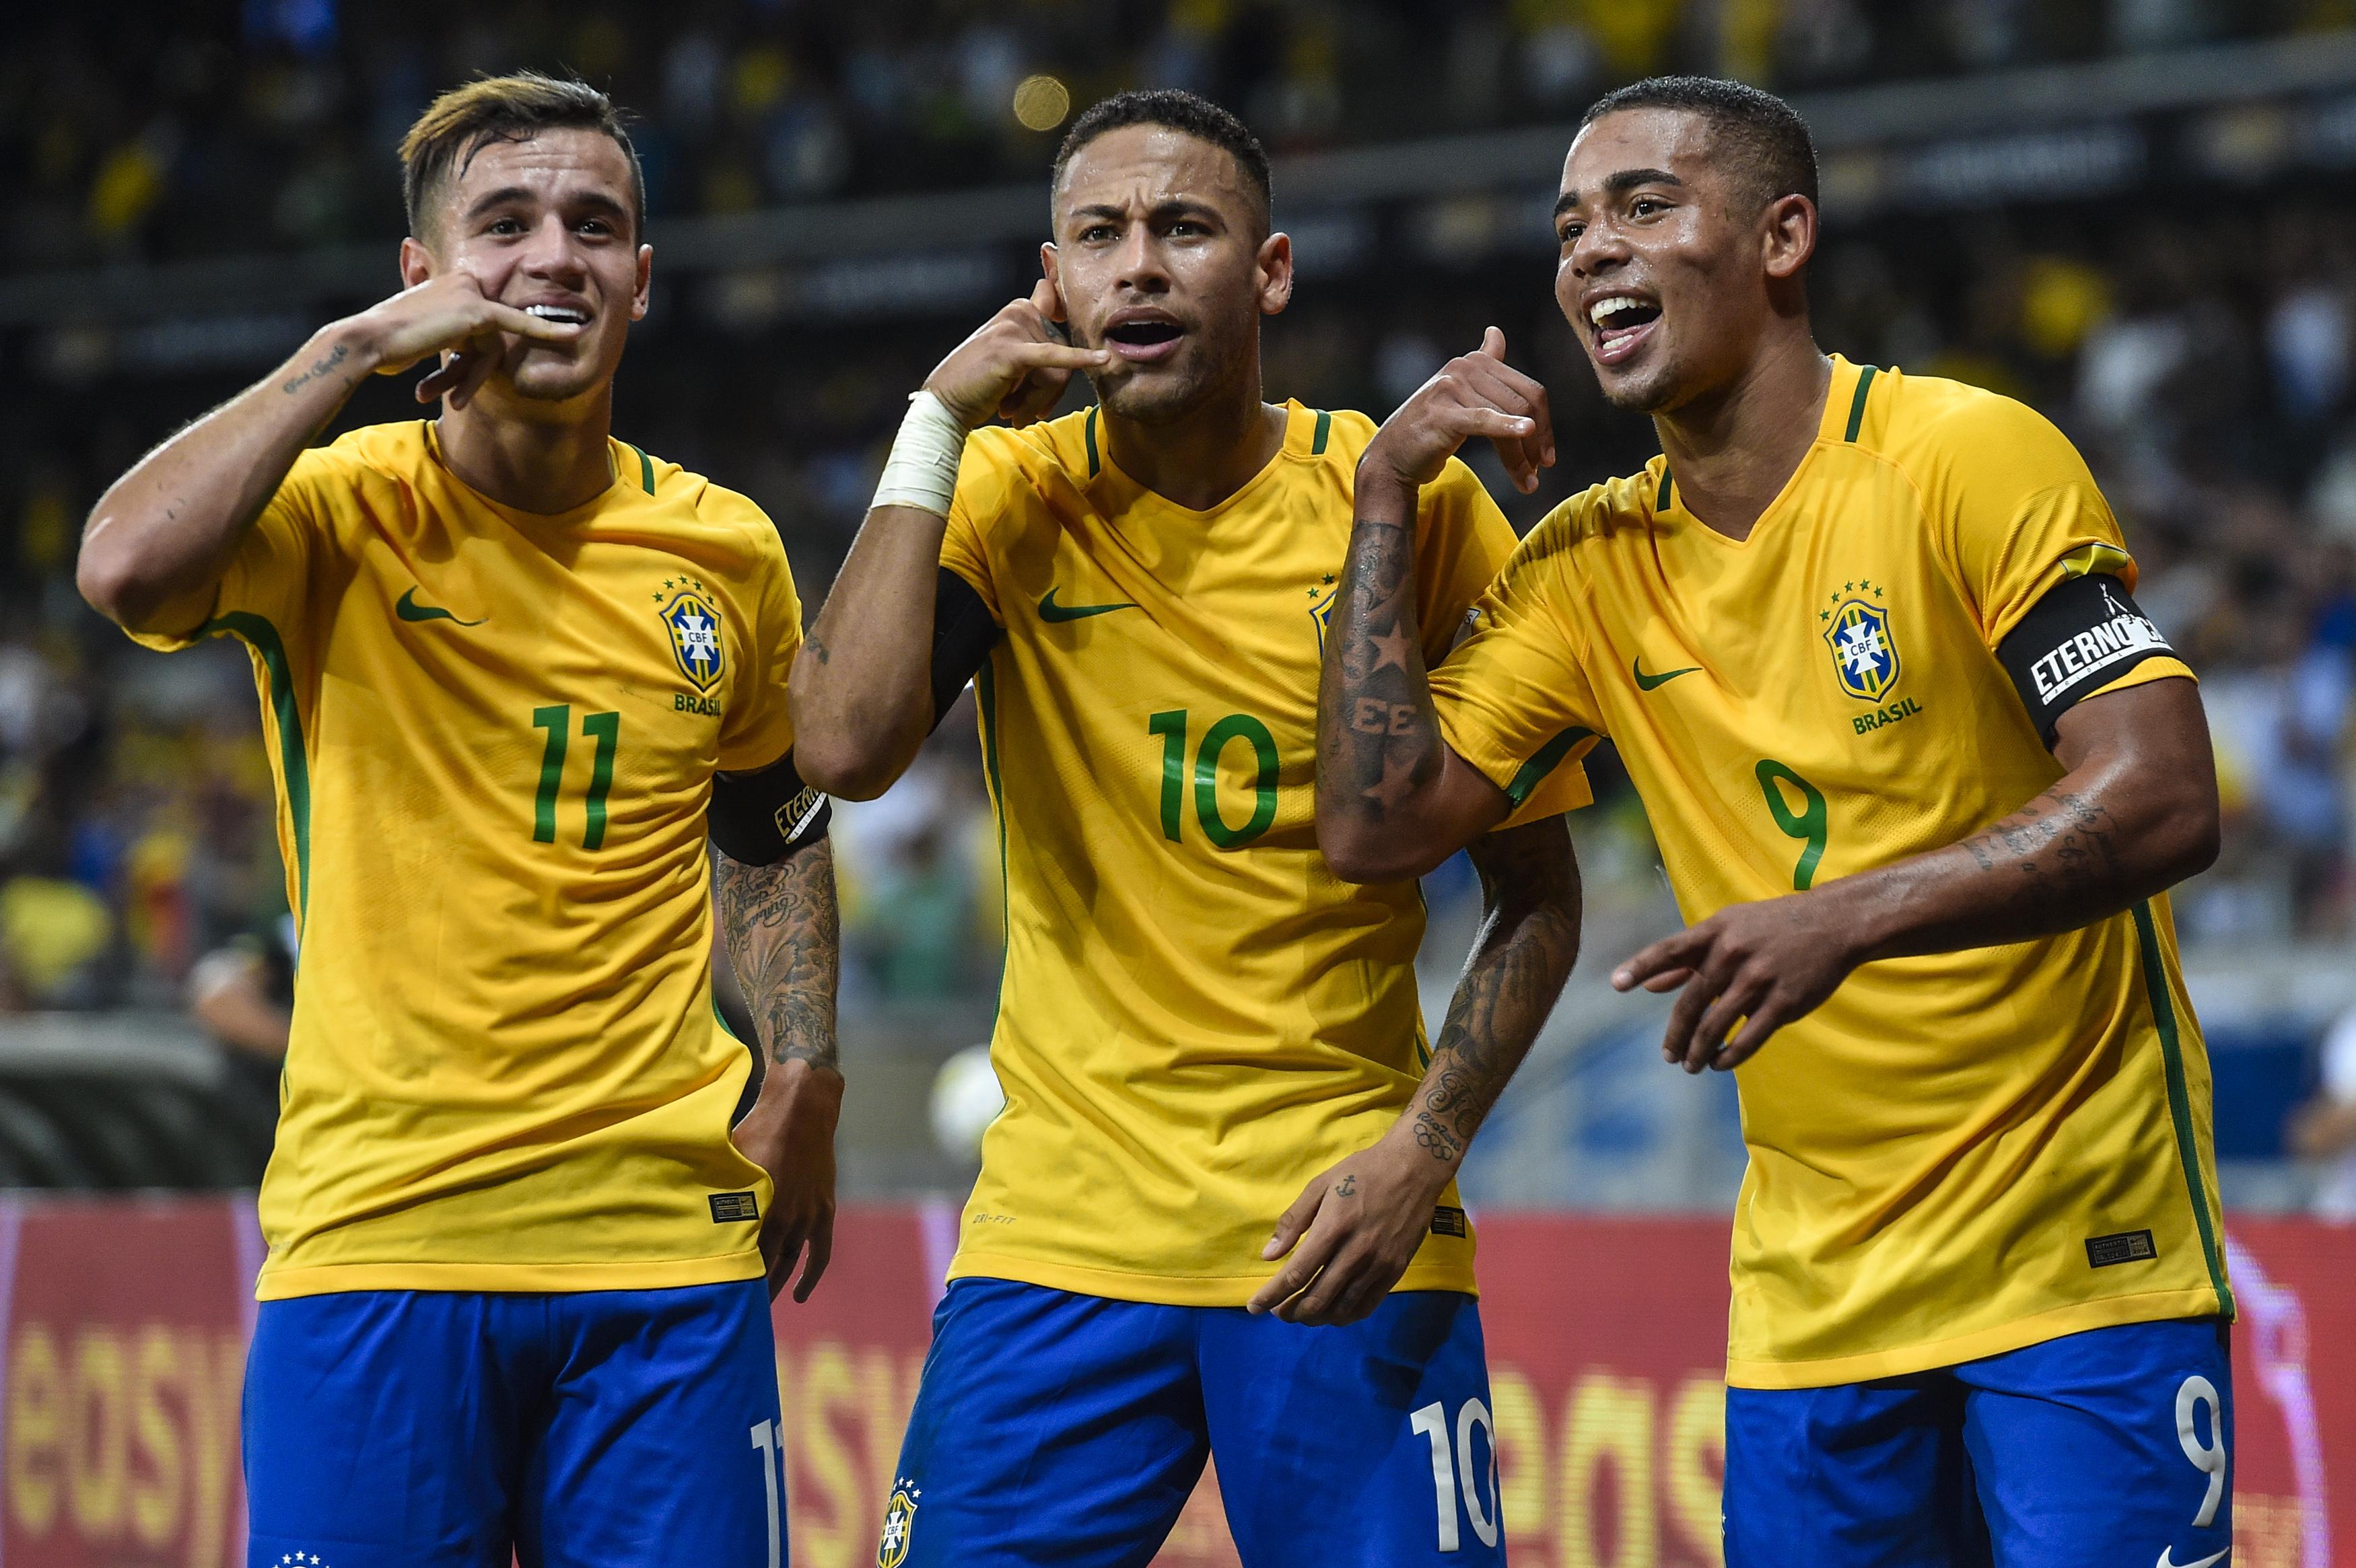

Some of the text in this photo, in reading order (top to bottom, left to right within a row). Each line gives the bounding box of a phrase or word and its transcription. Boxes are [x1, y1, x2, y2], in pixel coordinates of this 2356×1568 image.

[689, 632, 707, 643] CBF
[1850, 639, 1872, 656] CBF
[2030, 616, 2133, 695] ETERNO
[674, 694, 721, 717] BRASIL
[1852, 697, 1922, 735] BRASIL
[532, 704, 619, 851] 11
[1148, 709, 1280, 849] 10
[1755, 758, 1827, 891] 9
[973, 1213, 1016, 1225] DRI-FIT
[1410, 1396, 1498, 1553] 10
[2175, 1375, 2226, 1528] 9
[887, 1525, 899, 1536] CBF
